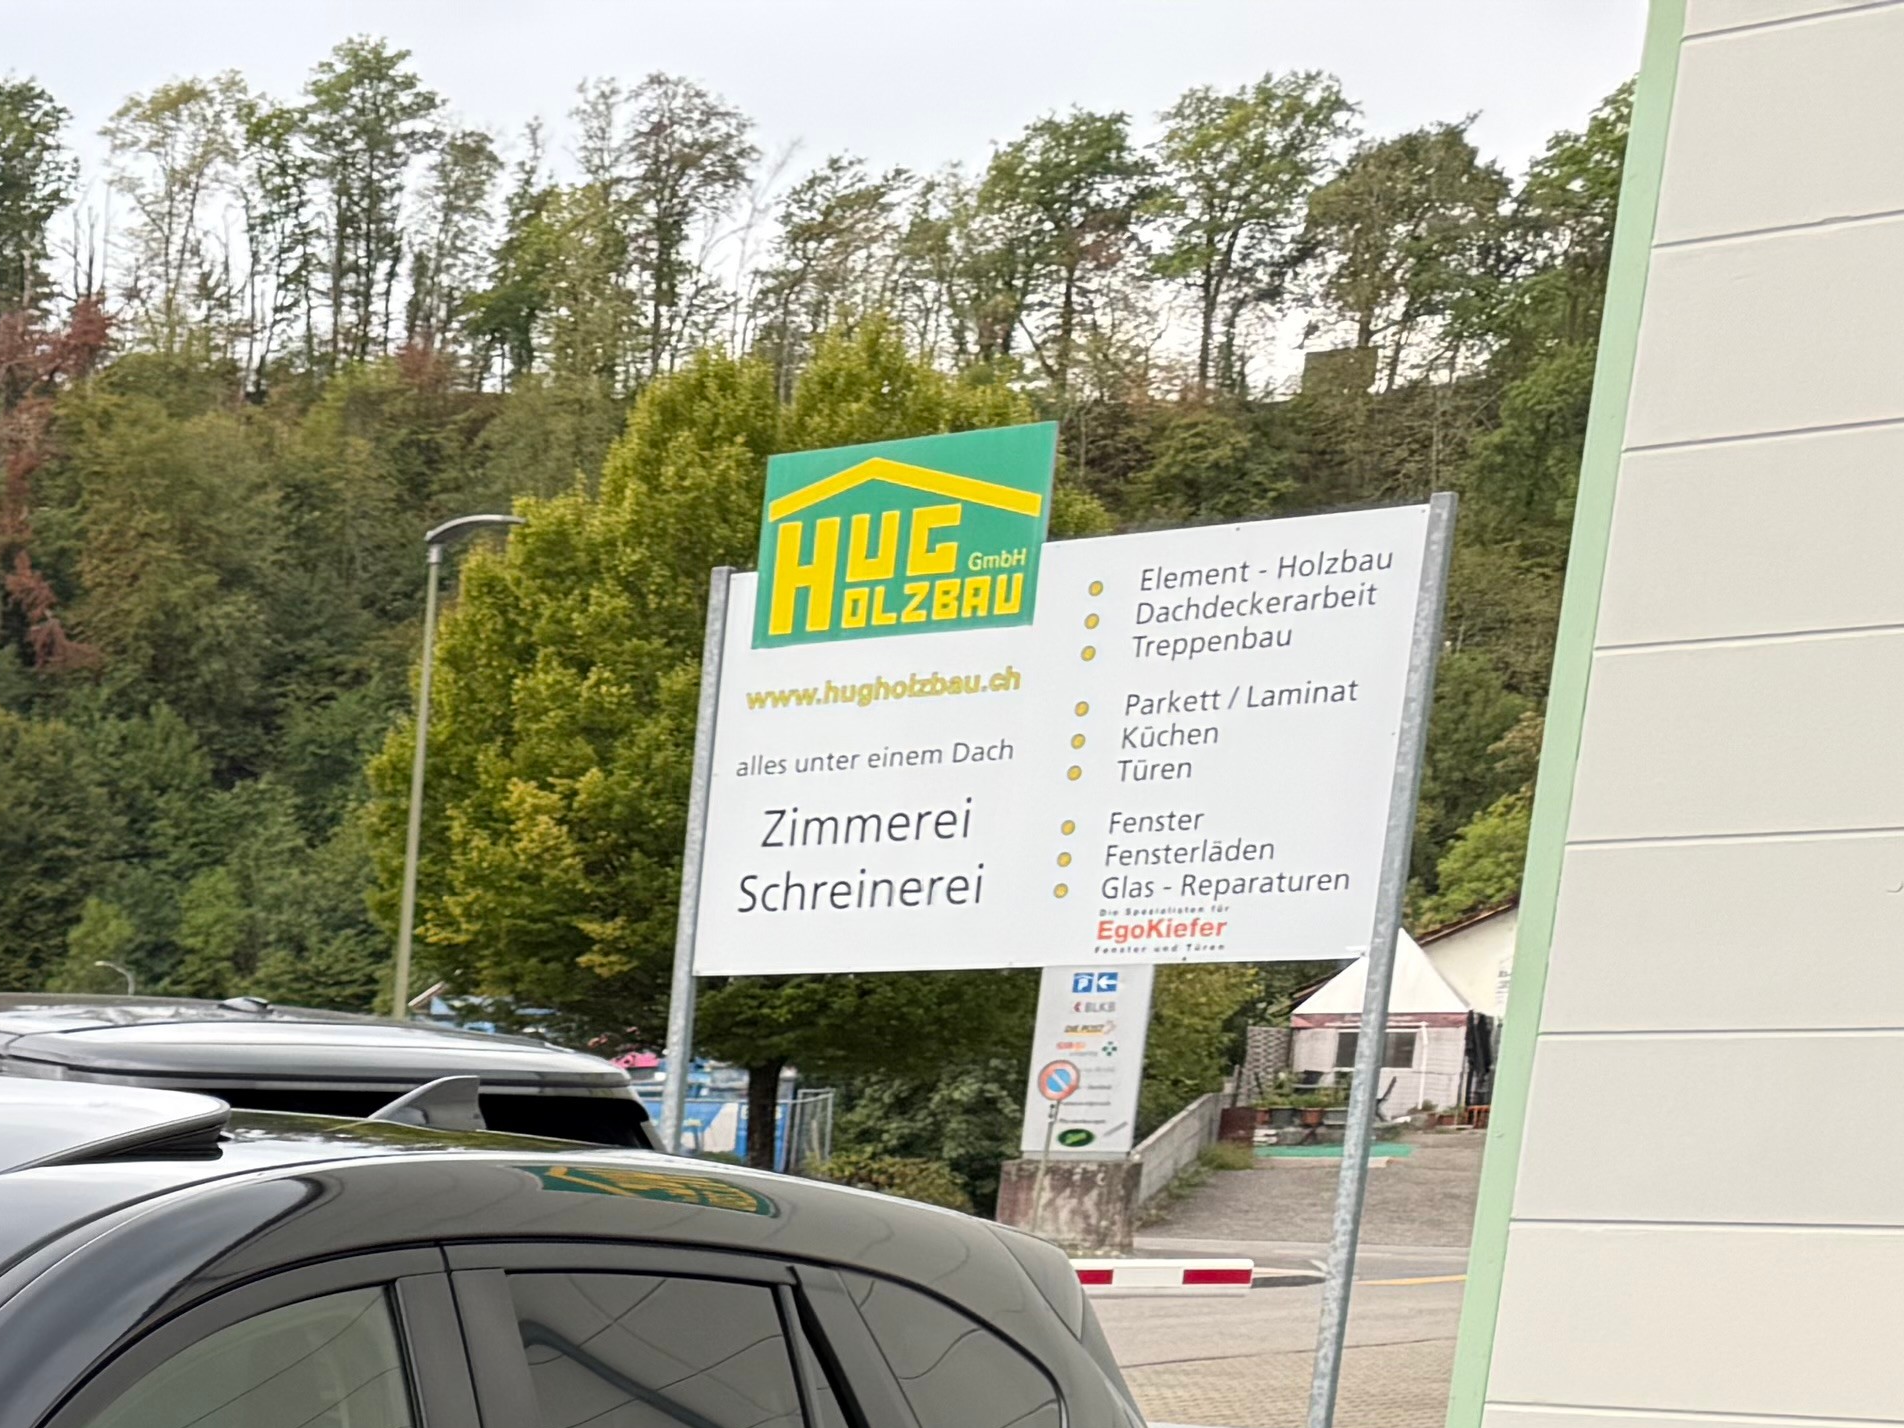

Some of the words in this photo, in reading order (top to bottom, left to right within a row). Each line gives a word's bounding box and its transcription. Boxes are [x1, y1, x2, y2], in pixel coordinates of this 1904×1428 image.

[768, 503, 962, 636] HUG
[967, 547, 1027, 573] GmbH
[1139, 560, 1251, 592] Element
[1276, 548, 1394, 580] Holzbau
[1135, 581, 1378, 626] Dachdeckerarbeit
[1132, 625, 1293, 662] Treppenbau
[745, 665, 1022, 710] www.hugholzbau.ch
[1124, 689, 1222, 717] Parkett
[1246, 679, 1360, 709] Laminat
[1120, 722, 1220, 750] Küchen
[735, 754, 788, 777] alles
[794, 751, 861, 774] unter
[867, 745, 943, 769] einem
[951, 738, 1015, 764] Dach
[1117, 758, 1193, 783] Türen
[760, 796, 973, 848] Zimmerei
[1108, 810, 1206, 835] Fenster
[1104, 837, 1276, 867] Fensterläden
[737, 862, 985, 914] Schreinerei
[1101, 875, 1155, 900] Glas
[1180, 870, 1351, 902] Reparaturen
[1096, 917, 1228, 944] EgoKiefer
